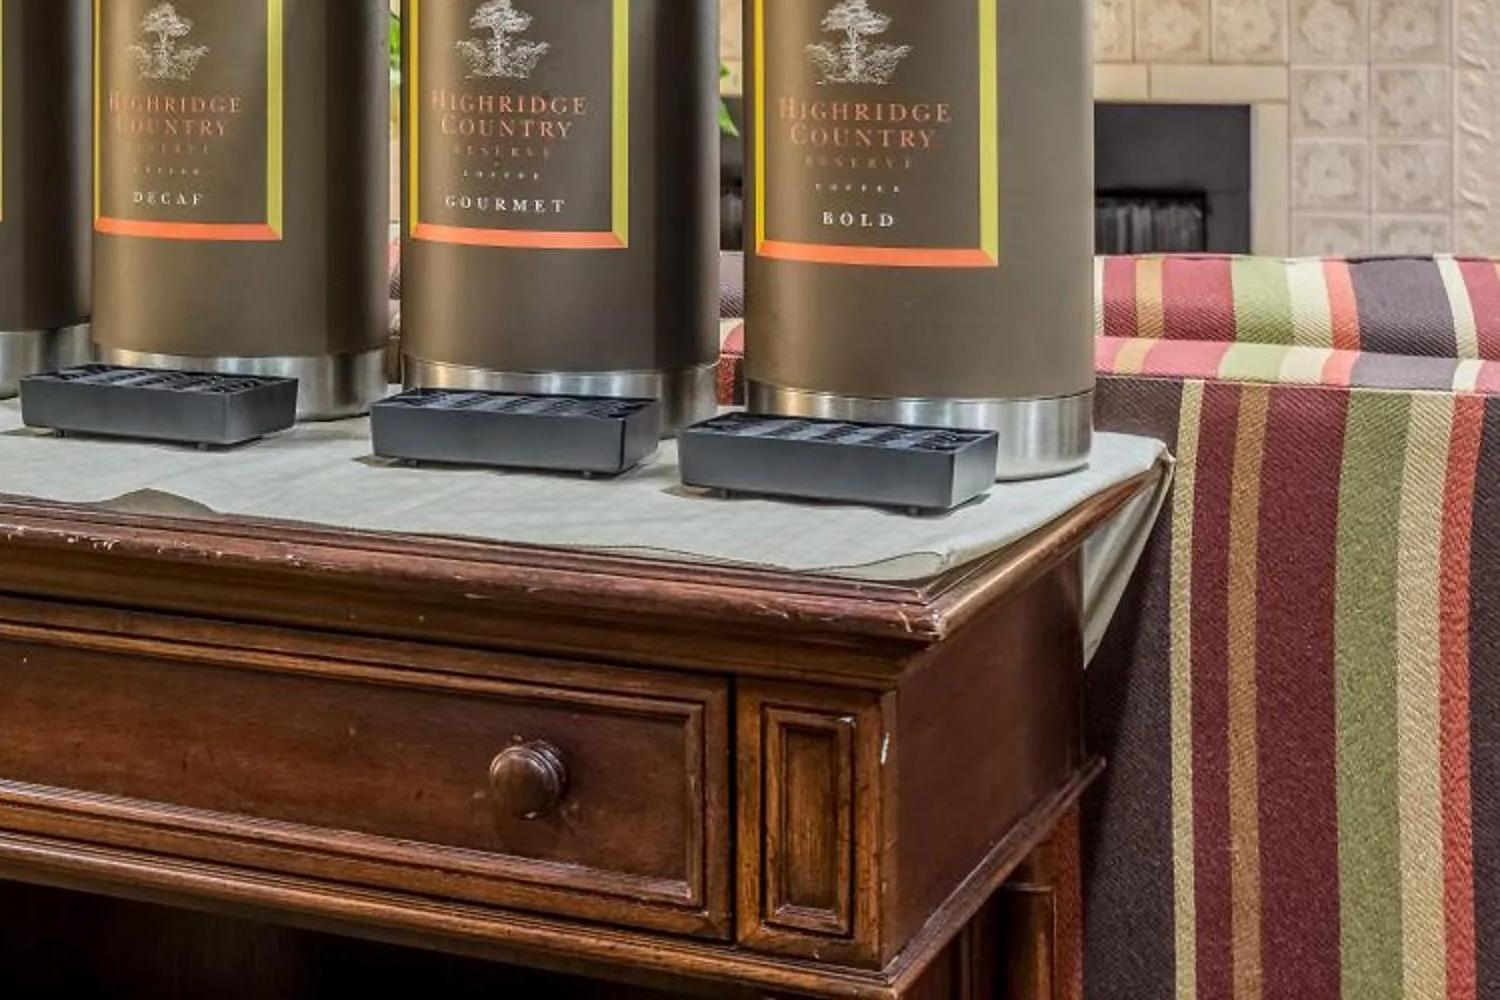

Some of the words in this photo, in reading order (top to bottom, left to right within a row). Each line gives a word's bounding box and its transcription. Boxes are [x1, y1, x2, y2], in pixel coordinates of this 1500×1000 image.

[432, 90, 587, 115] HIGHRIDGE
[778, 96, 952, 123] HIGHRIDGE
[441, 115, 572, 138] COUNTRY
[790, 121, 937, 148] COUNTRY
[132, 191, 203, 206] DECAF
[444, 195, 565, 213] GOURMET
[822, 211, 894, 228] BOLD
